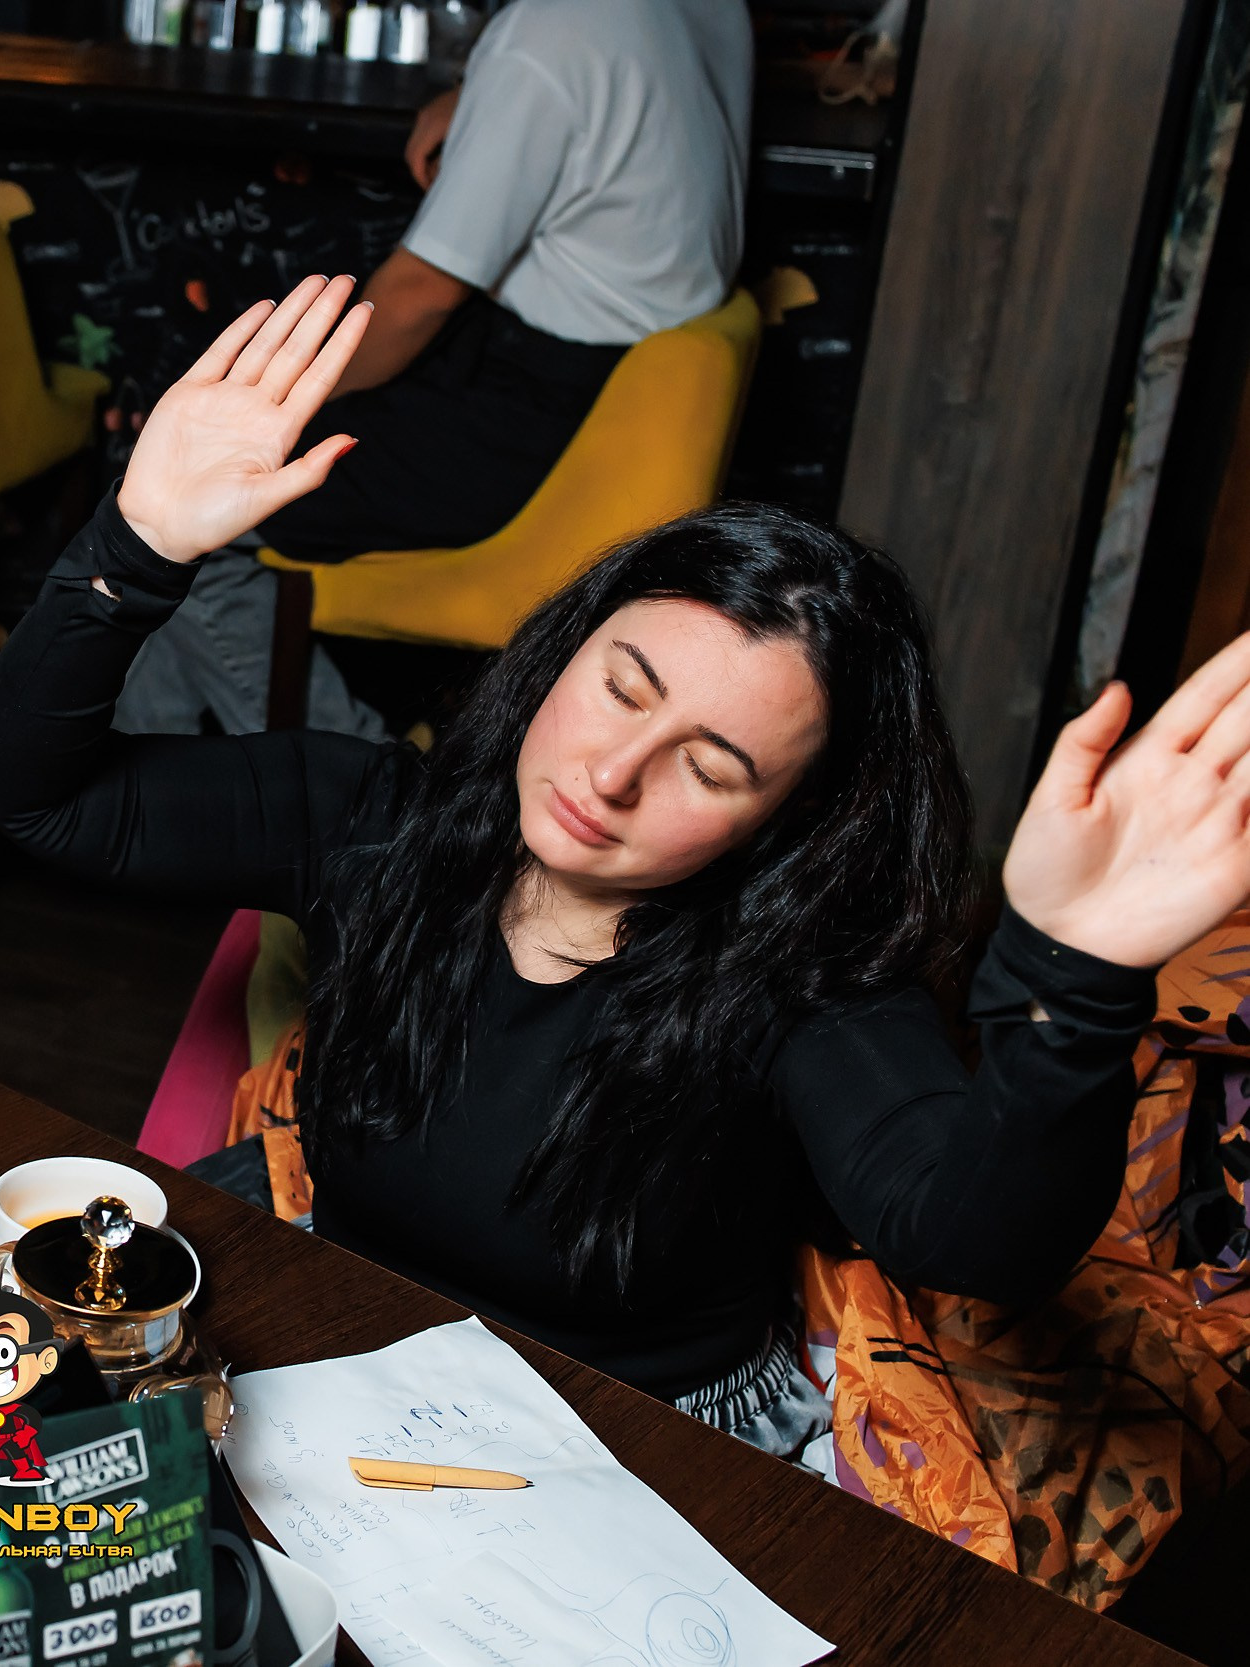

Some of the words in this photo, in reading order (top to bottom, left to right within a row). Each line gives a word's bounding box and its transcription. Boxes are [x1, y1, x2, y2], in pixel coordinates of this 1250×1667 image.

[69, 1582, 87, 1610] В
[88, 1546, 178, 1602] ПОДАРОК
[50, 1618, 117, 1650] 3000
